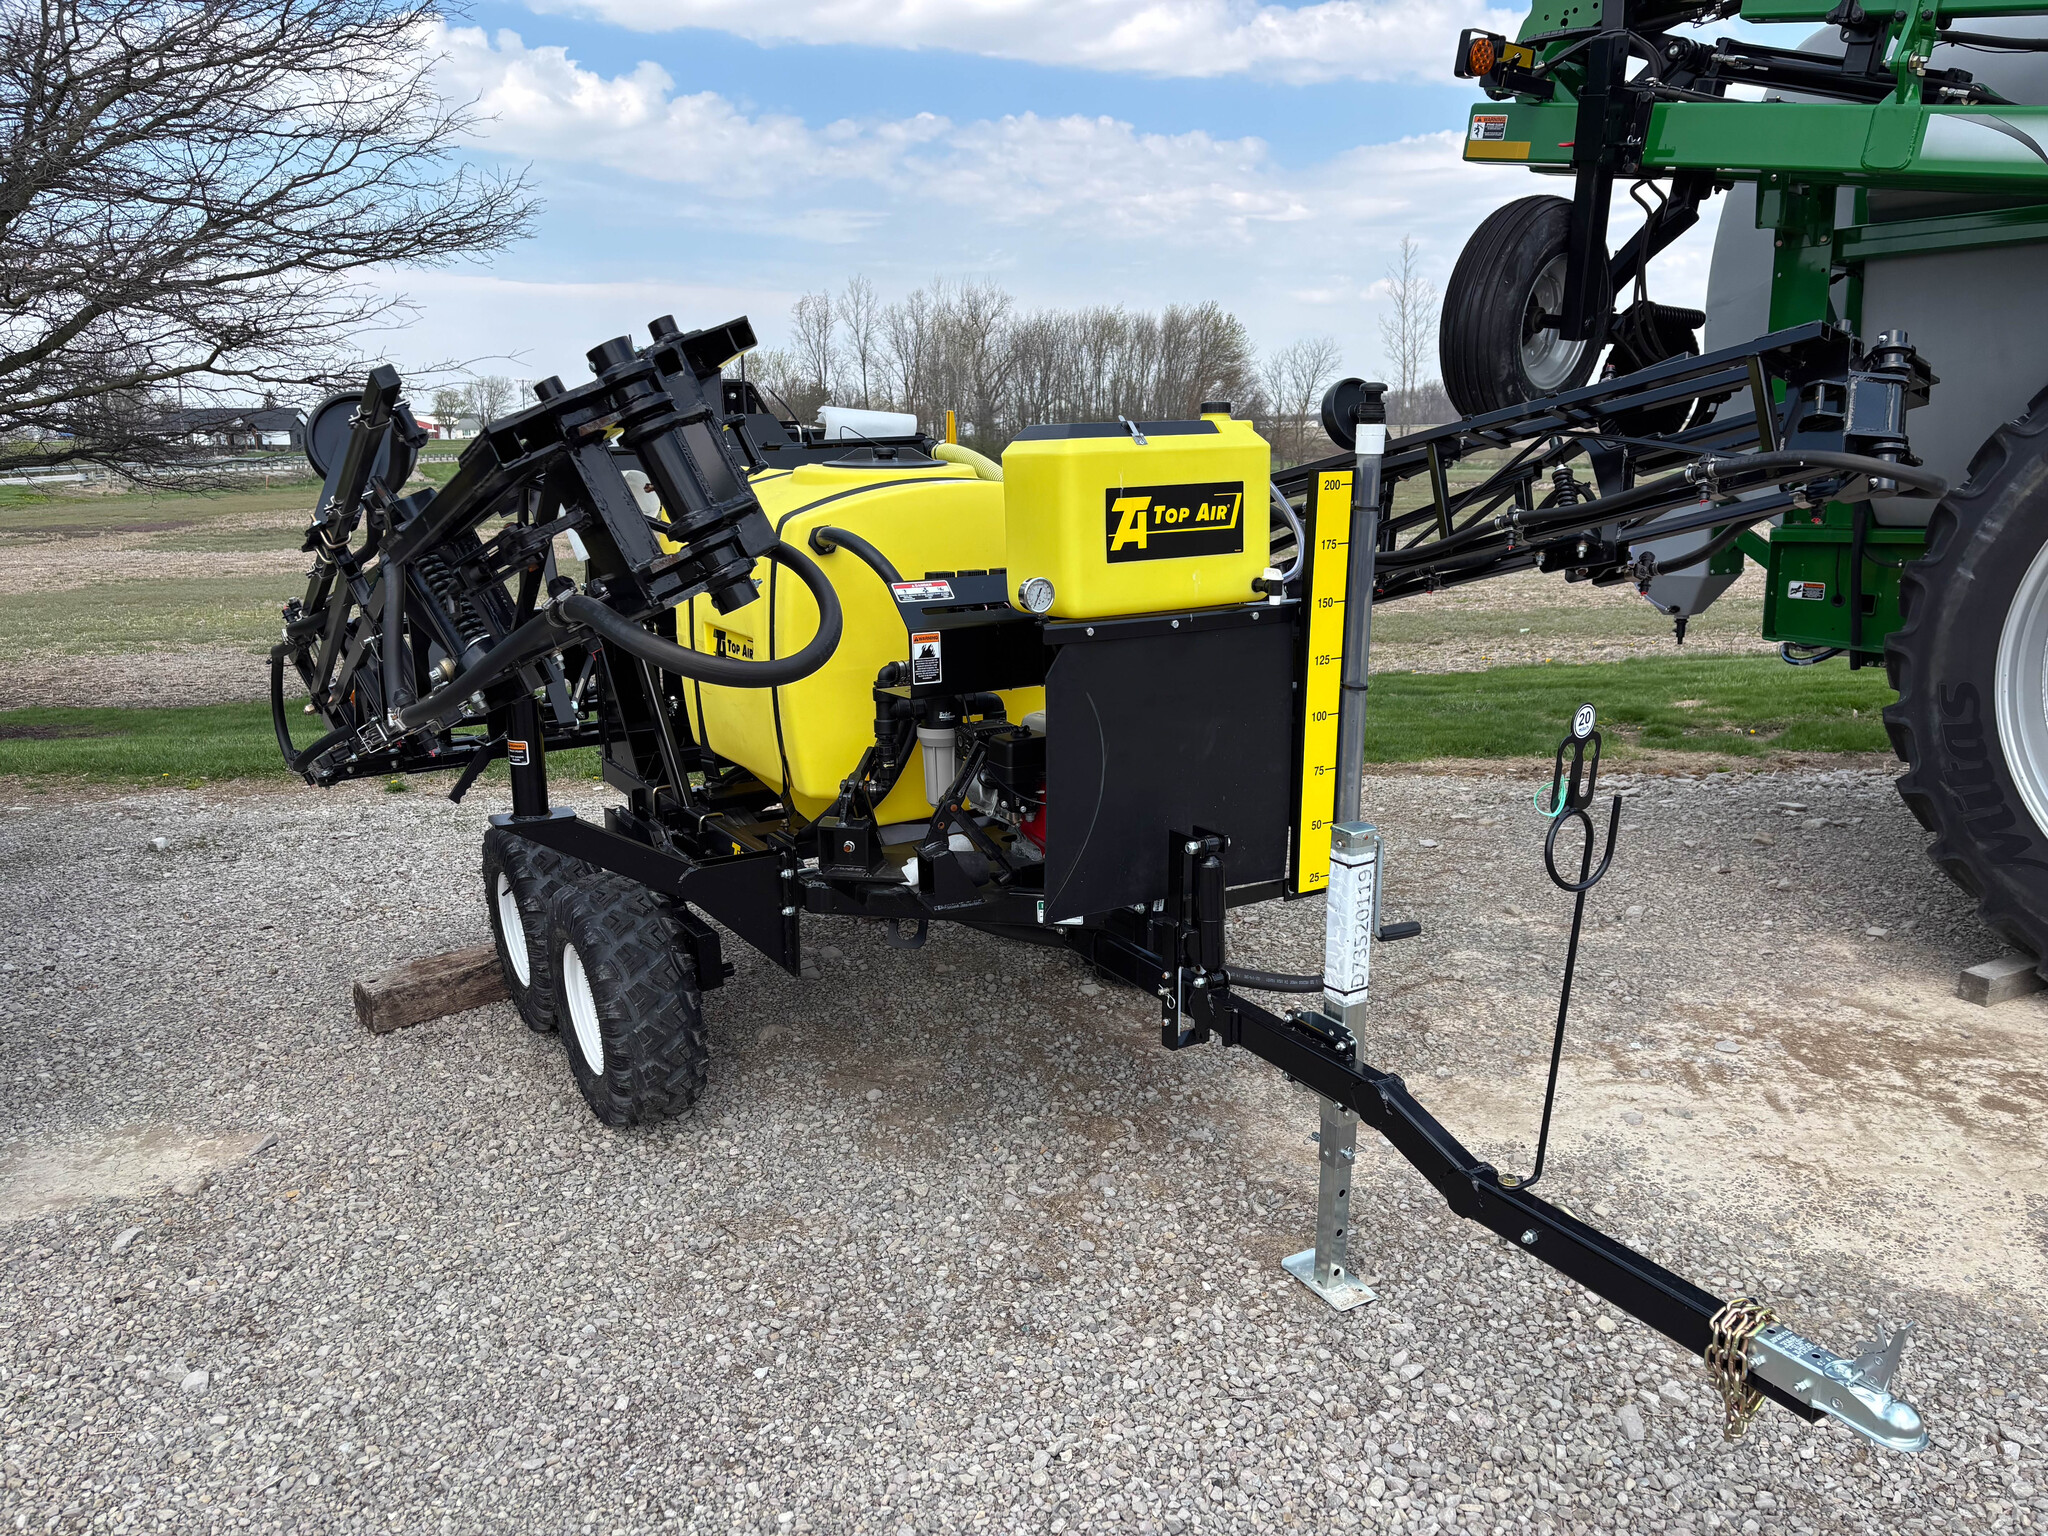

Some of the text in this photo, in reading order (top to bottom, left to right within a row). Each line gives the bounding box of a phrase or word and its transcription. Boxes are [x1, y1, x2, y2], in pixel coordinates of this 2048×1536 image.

[1324, 480, 1340, 490] 200
[1321, 539, 1337, 550] 175
[1318, 597, 1333, 608] 150
[1315, 655, 1330, 665] 125
[1312, 711, 1327, 721] 100
[1578, 710, 1591, 726] 20
[1314, 766, 1324, 776] 75
[1311, 820, 1322, 830] 50
[1309, 872, 1320, 882] 25
[1351, 869, 1372, 989] D73520119
